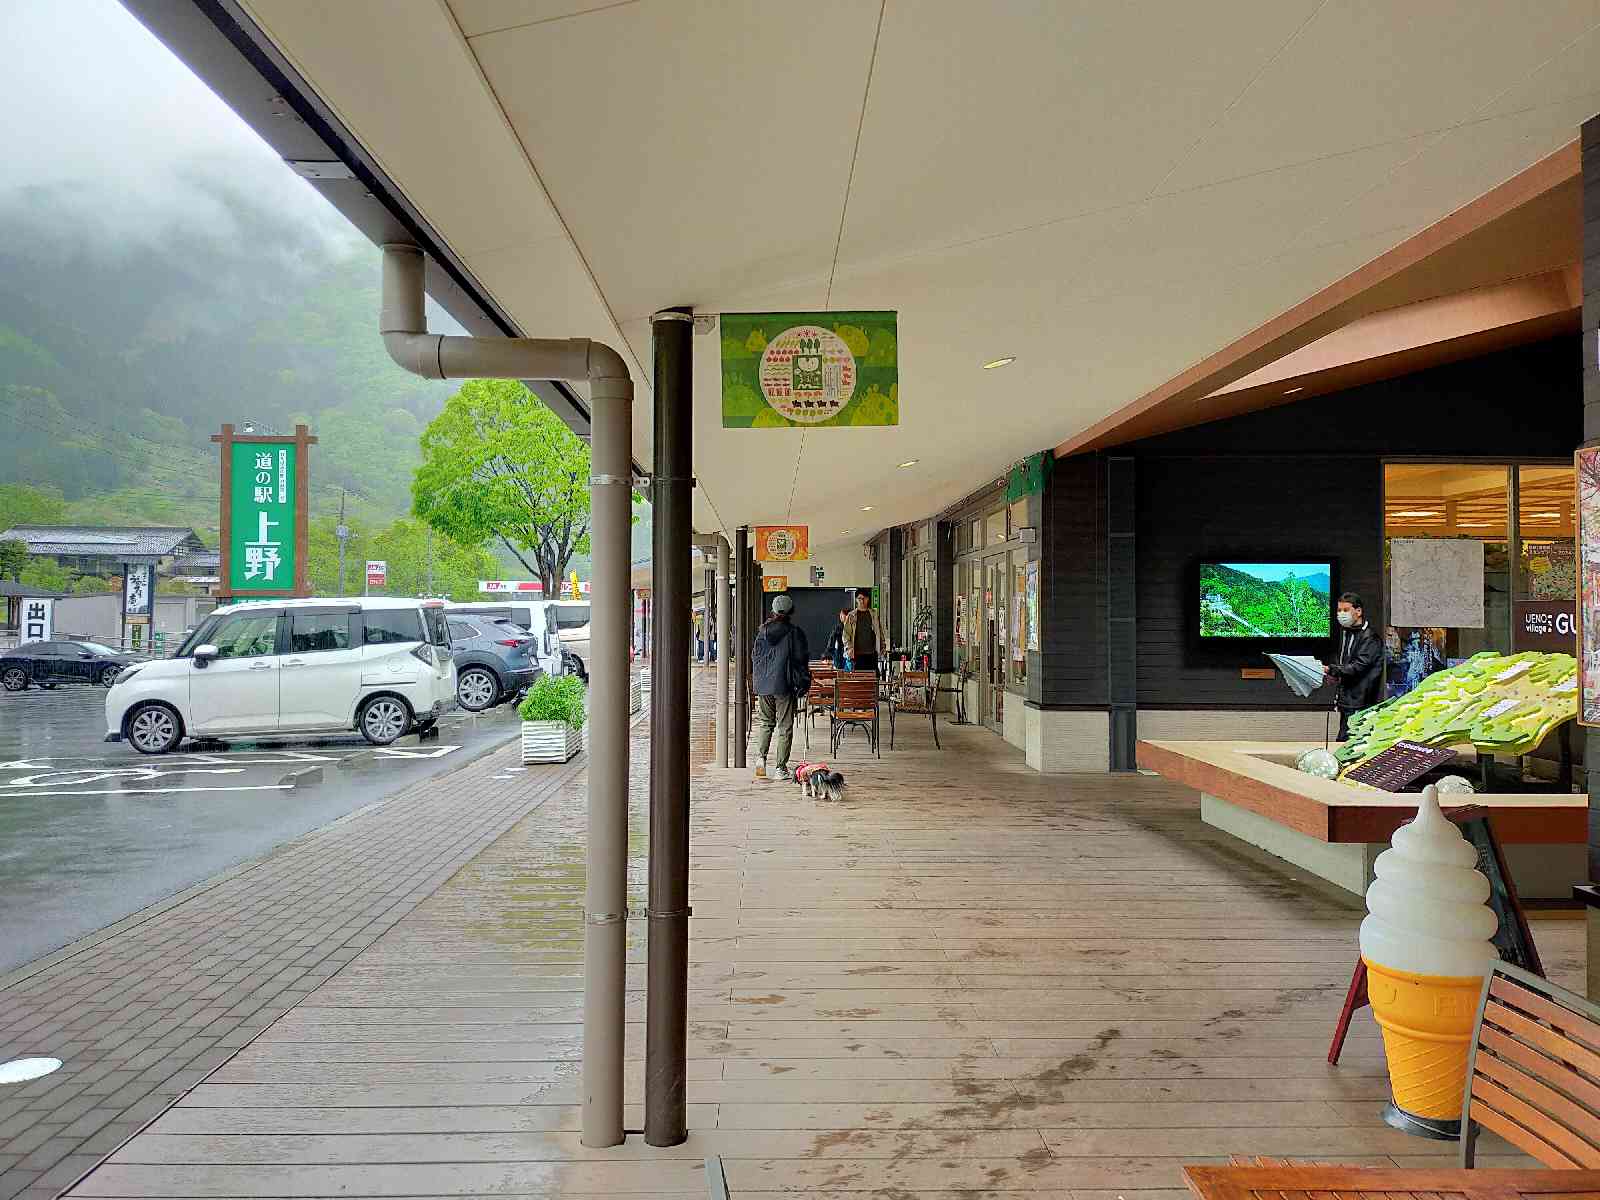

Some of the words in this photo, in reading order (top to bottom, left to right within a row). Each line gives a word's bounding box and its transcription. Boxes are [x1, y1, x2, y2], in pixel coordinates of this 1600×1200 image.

[254, 452, 273, 503] 道の駅
[244, 511, 281, 580] 上野
[28, 603, 45, 639] 出口
[1525, 613, 1547, 623] UENO
[1525, 624, 1546, 634] village
